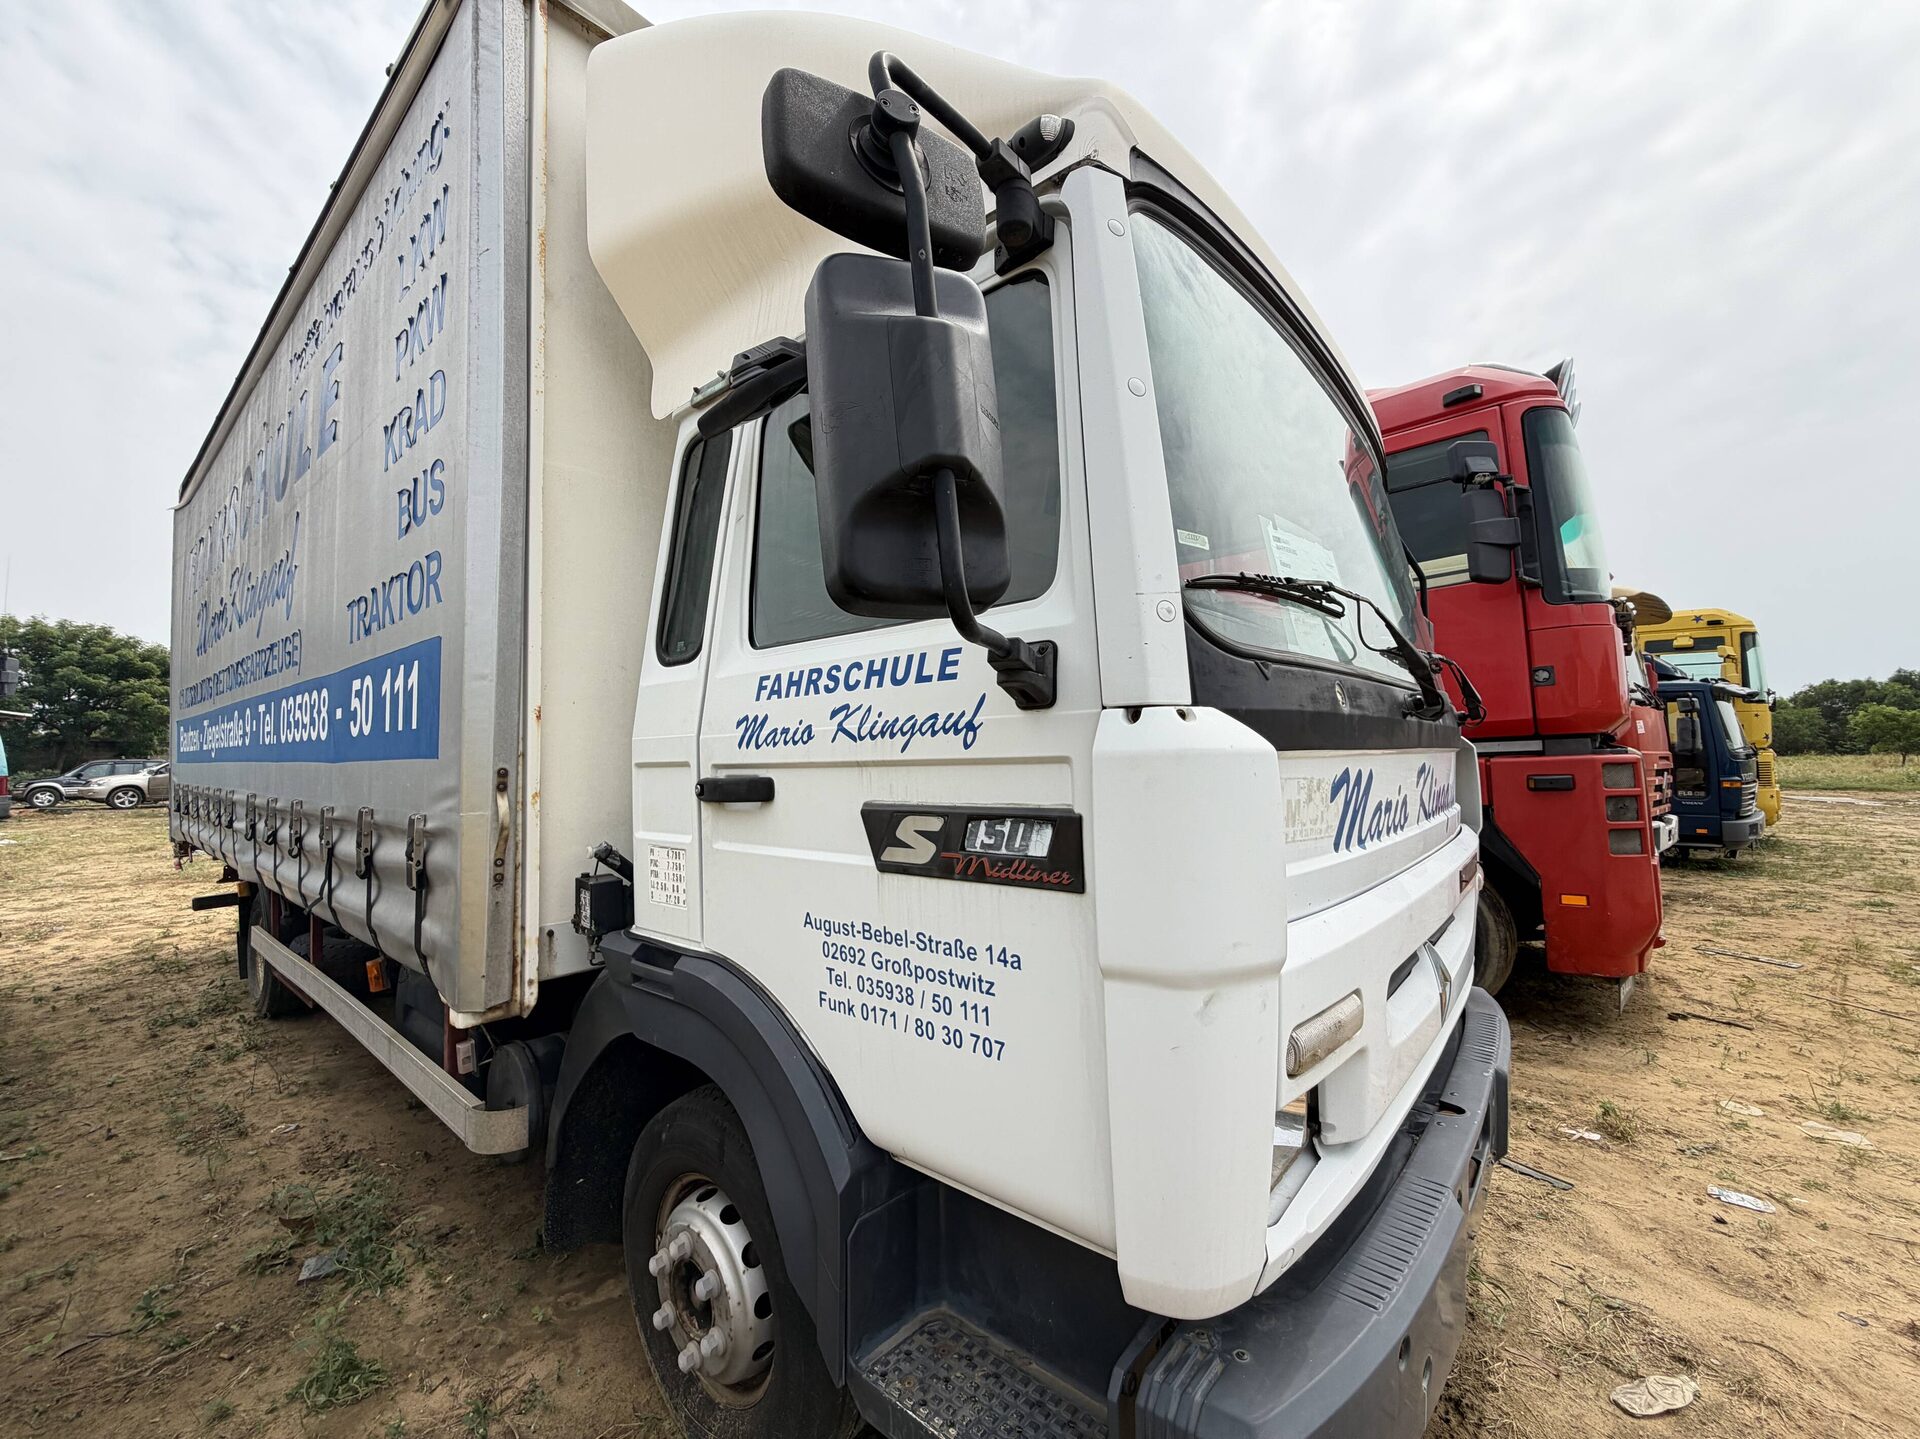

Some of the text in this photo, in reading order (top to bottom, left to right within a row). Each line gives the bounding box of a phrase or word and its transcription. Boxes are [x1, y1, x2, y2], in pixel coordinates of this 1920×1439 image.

[397, 183, 449, 302] LKW
[395, 272, 448, 382] PKW
[383, 369, 446, 472] KRAD
[397, 458, 445, 540] BUS
[346, 550, 442, 644] TRAKTOR
[203, 709, 243, 758] Ziegelstraße
[245, 707, 251, 746] 9
[258, 702, 277, 745] Tel.
[280, 687, 329, 744] 035938
[350, 674, 374, 737] 50
[382, 660, 419, 733] 111
[755, 647, 963, 702] FAHRSCHULE
[736, 692, 987, 754] Mario Klingauf
[880, 815, 945, 865] S
[1329, 766, 1409, 854] Mario
[940, 852, 1074, 886] Midliner
[803, 911, 1023, 971] August-Bebel-Straße 14a
[822, 940, 996, 997] 02692 Großpostwitz
[818, 990, 1006, 1061] Funk 0171 / 80 30 707
[825, 966, 990, 1027] Tel. 035938 / 50 111
